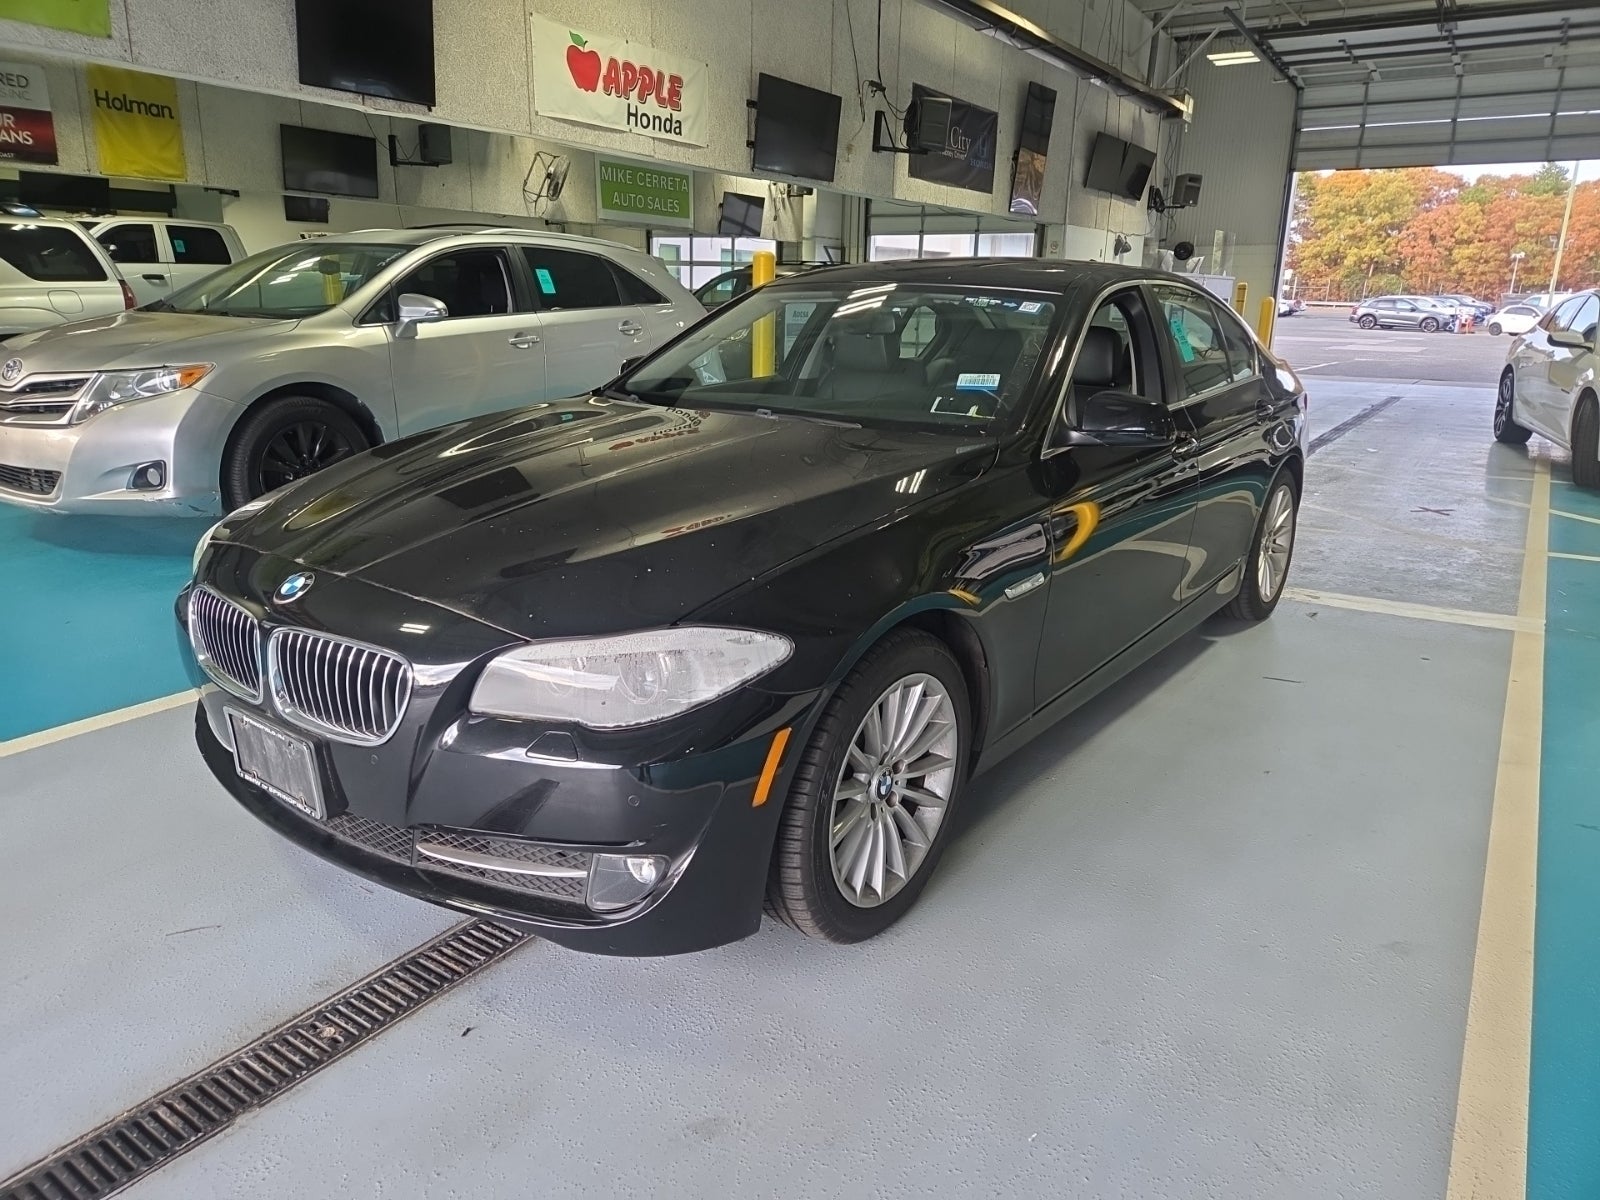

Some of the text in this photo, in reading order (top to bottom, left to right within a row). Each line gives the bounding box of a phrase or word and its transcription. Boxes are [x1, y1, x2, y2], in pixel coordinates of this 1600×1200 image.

[603, 57, 683, 111] APPLE
[94, 89, 174, 119] Holman
[627, 103, 682, 136] Honda
[951, 126, 972, 157] City
[601, 166, 688, 192] MIKE CERRETA
[613, 192, 680, 213] AUTO SALES
